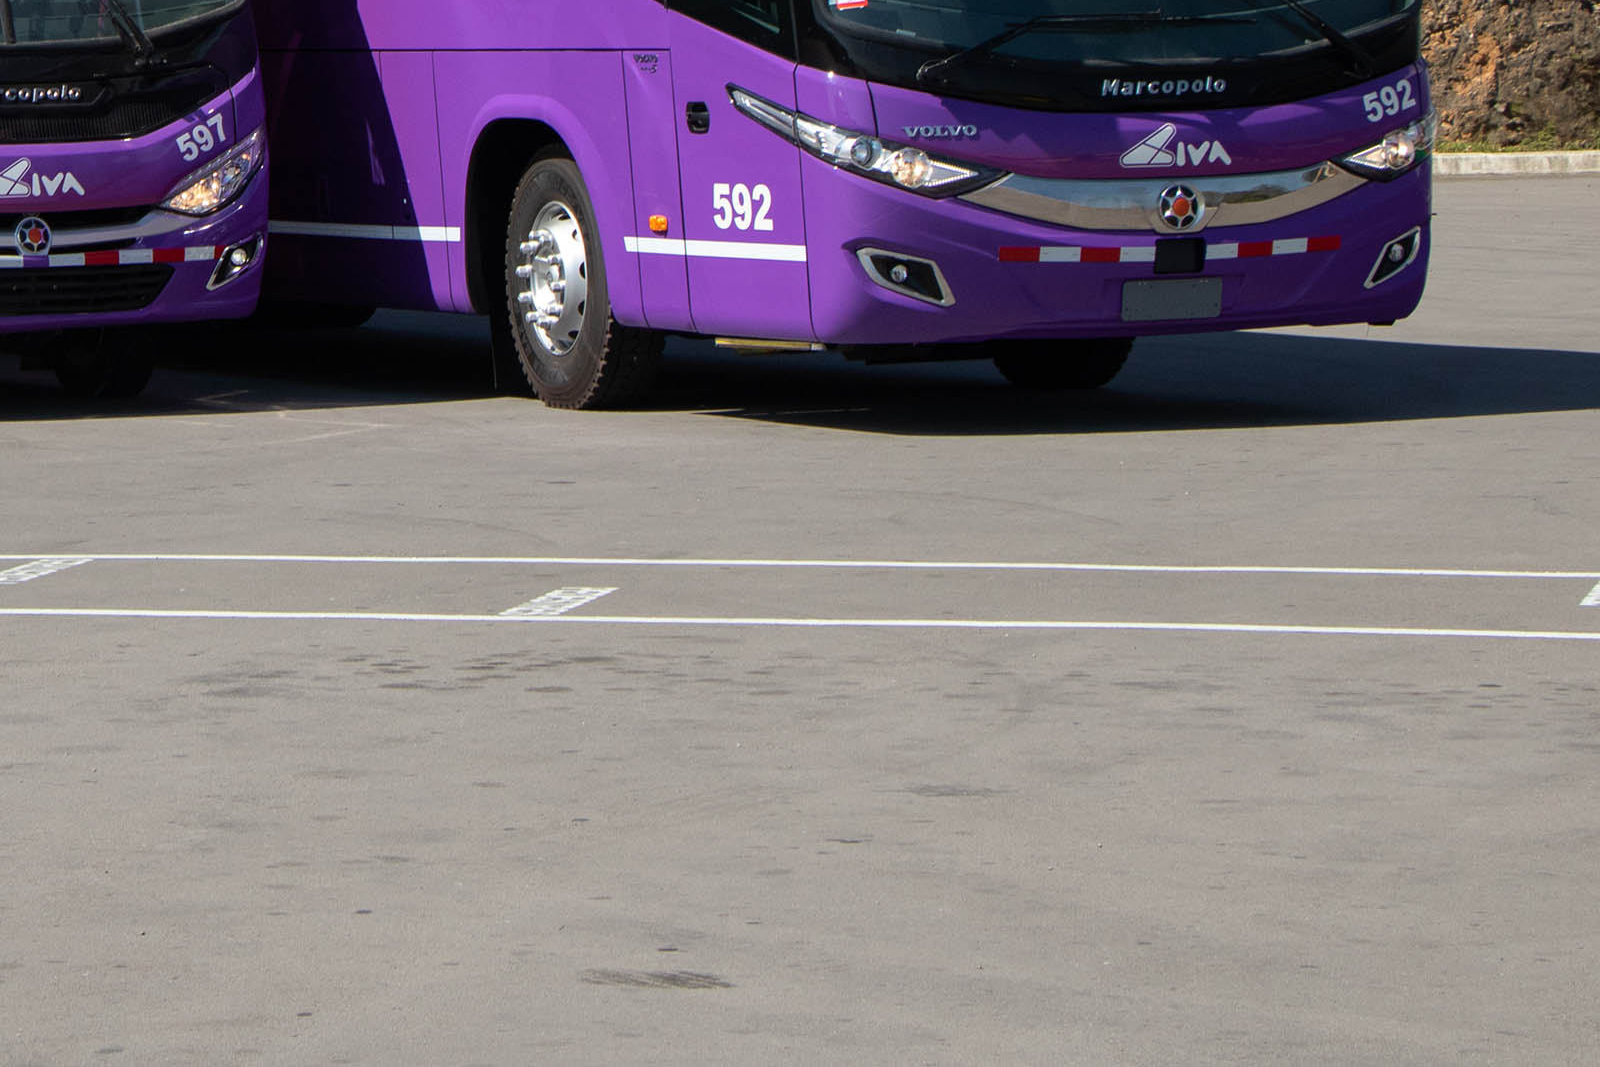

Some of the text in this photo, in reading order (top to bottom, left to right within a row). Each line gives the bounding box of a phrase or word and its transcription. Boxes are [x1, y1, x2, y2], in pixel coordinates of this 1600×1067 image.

[1101, 76, 1227, 97] Marcopolo
[1362, 78, 1417, 123] 592
[176, 112, 227, 162] 597
[903, 124, 977, 138] VOLVO
[713, 182, 774, 231] 592
